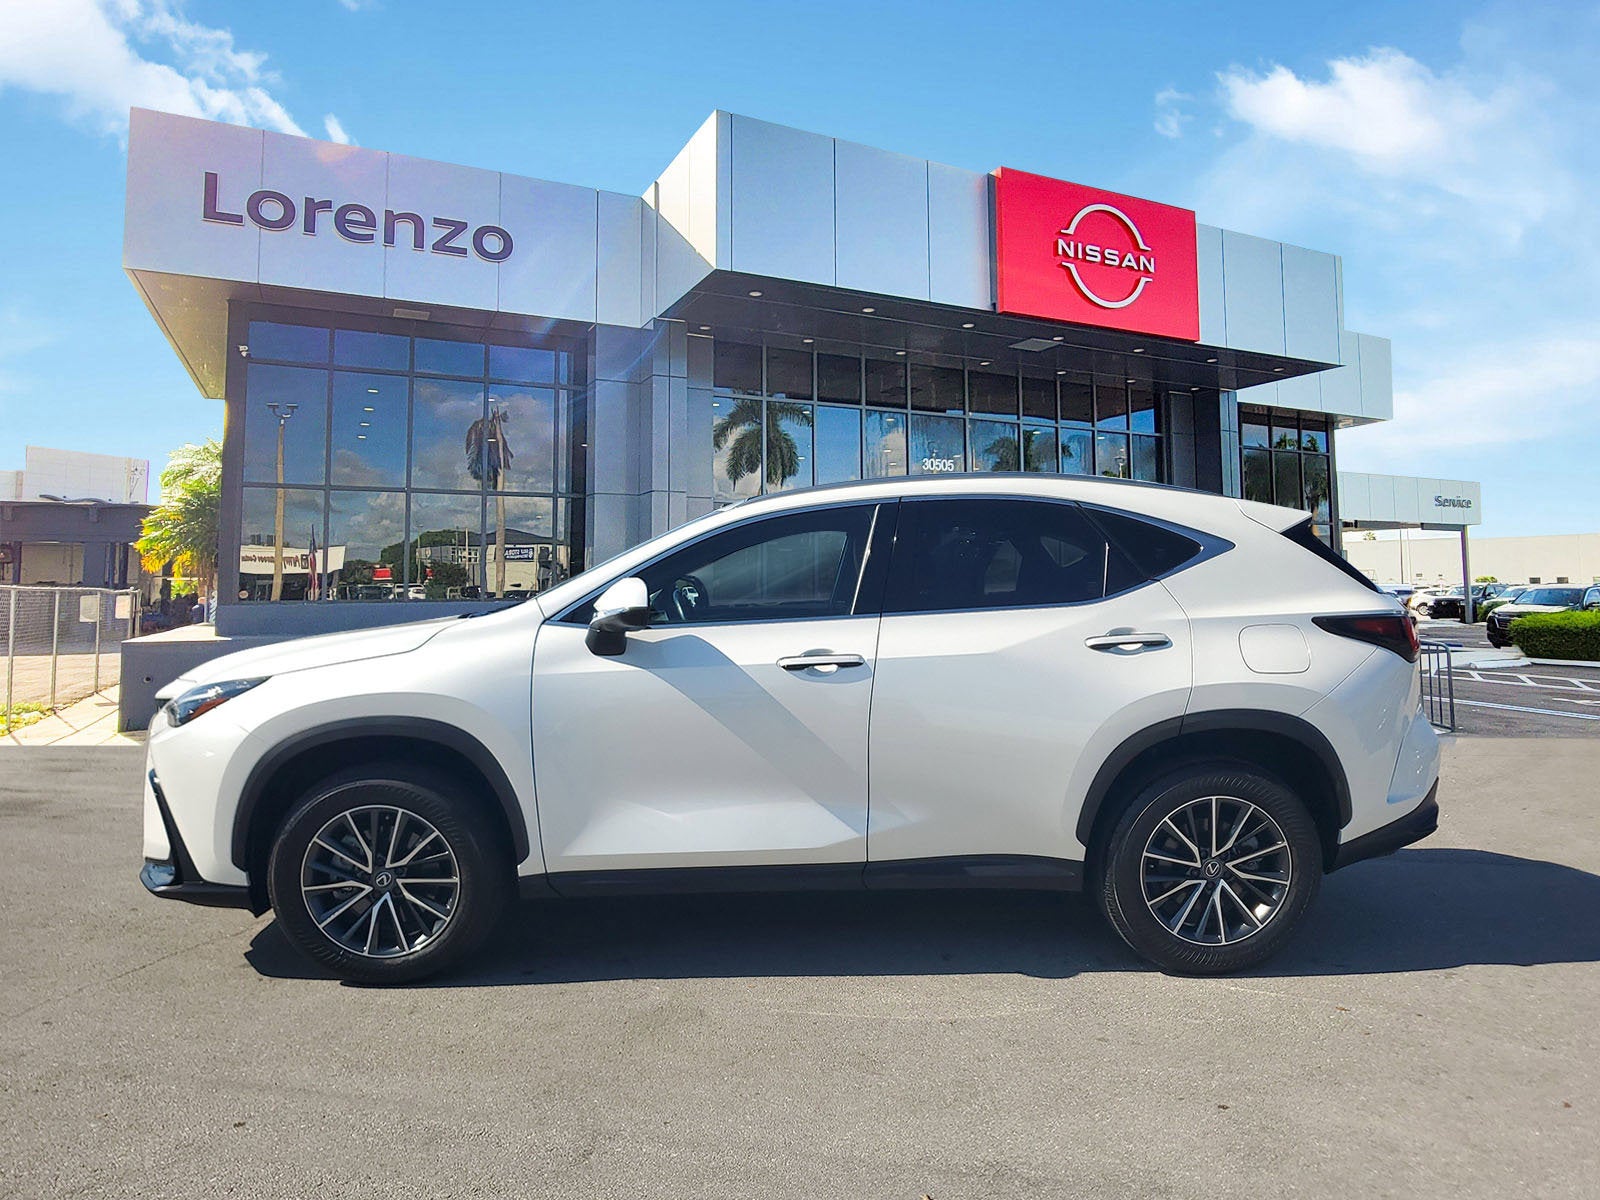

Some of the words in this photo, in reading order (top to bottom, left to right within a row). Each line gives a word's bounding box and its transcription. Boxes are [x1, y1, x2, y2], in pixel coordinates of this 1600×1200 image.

[202, 171, 514, 262] Lorenzo
[1057, 238, 1155, 273] NISSAN
[922, 457, 955, 471] 30505
[1434, 495, 1472, 508] Service
